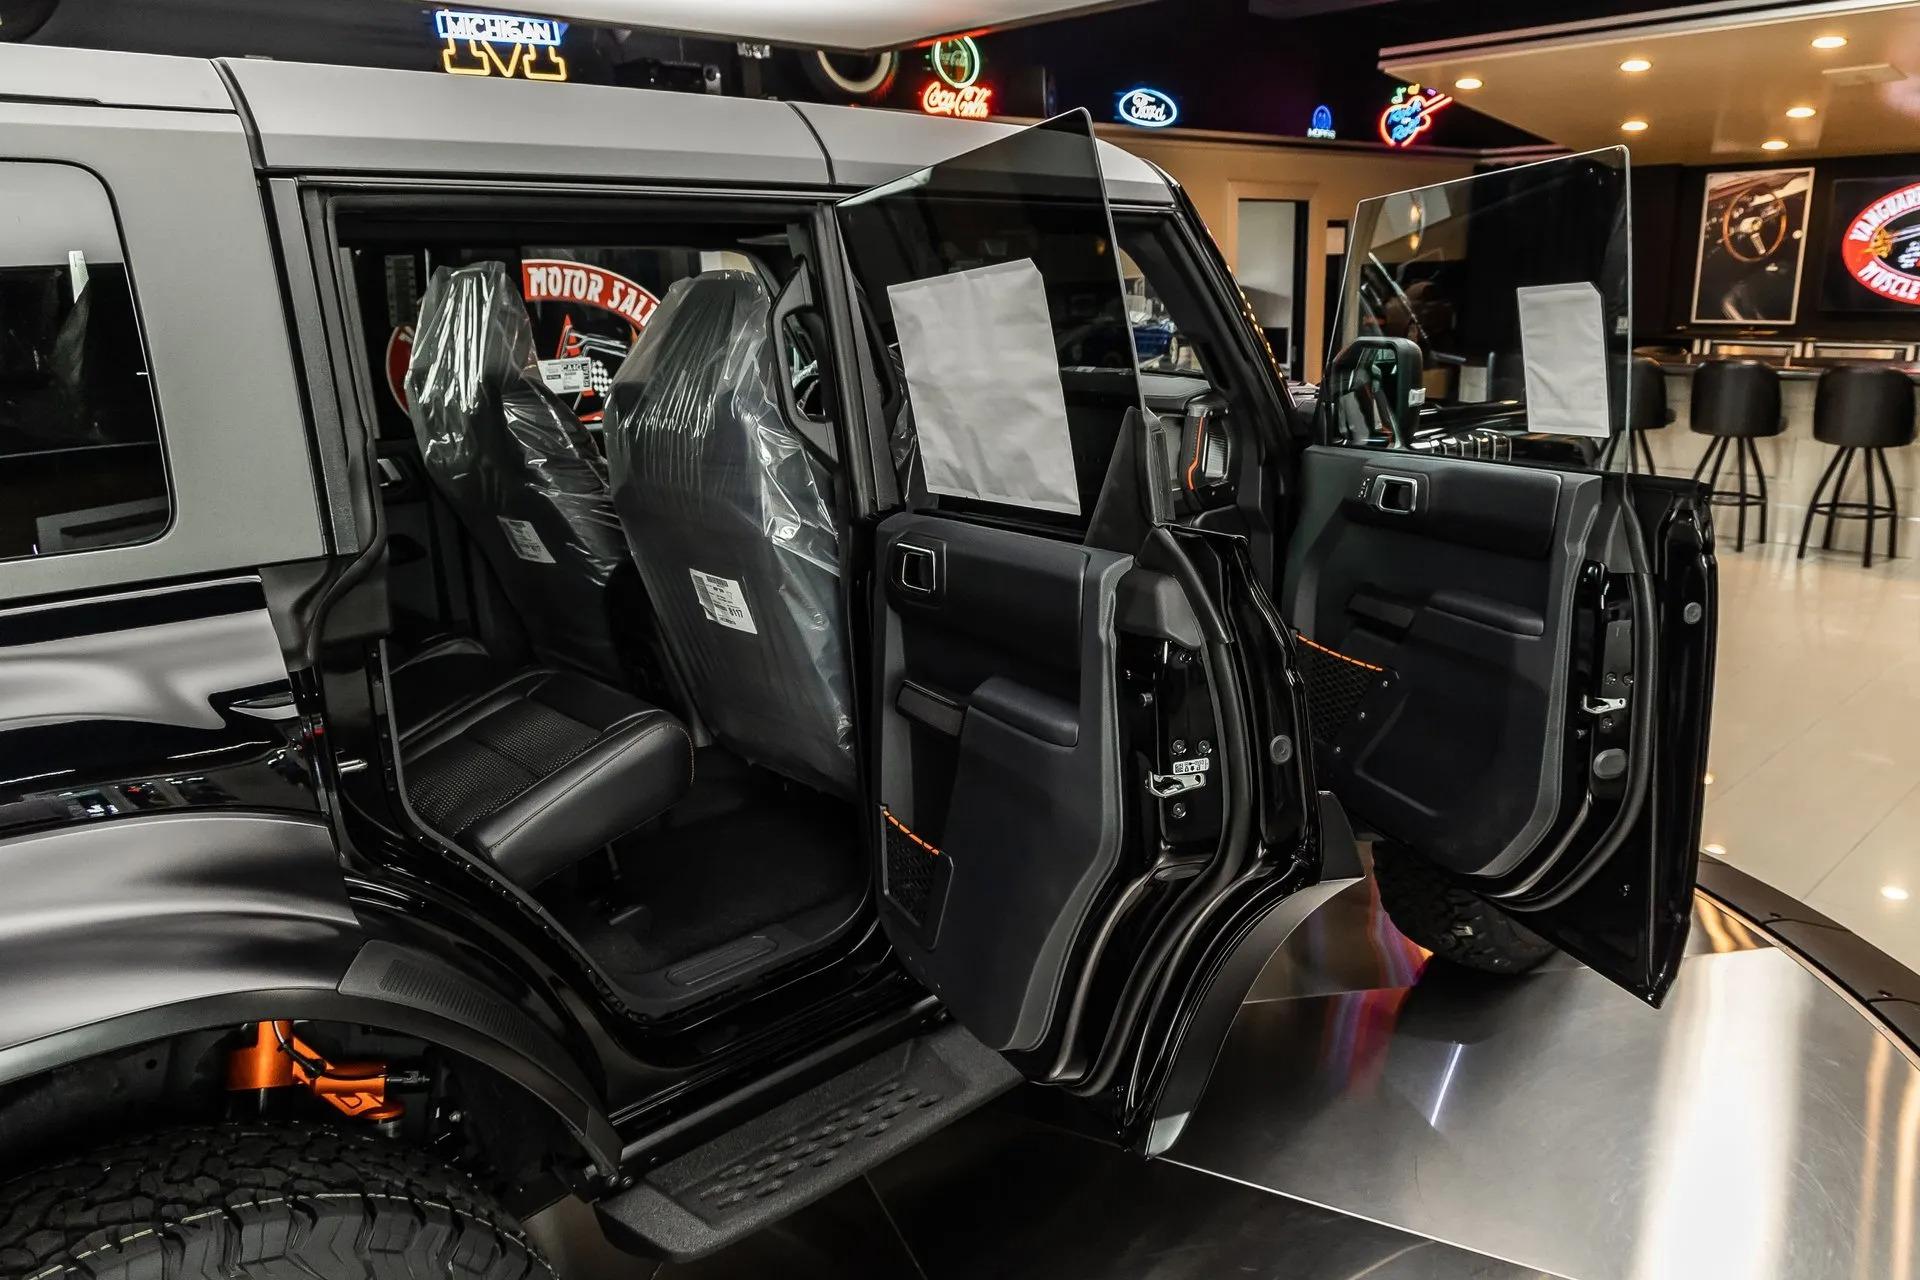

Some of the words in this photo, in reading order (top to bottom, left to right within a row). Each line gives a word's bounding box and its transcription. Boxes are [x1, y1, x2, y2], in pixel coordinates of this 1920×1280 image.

[446, 13, 550, 42] MICHIGAN
[1131, 92, 1166, 121] Ford
[1849, 186, 1920, 242] VANGUAR
[527, 266, 604, 301] MOTOR
[1858, 260, 1920, 300] MUSCLE
